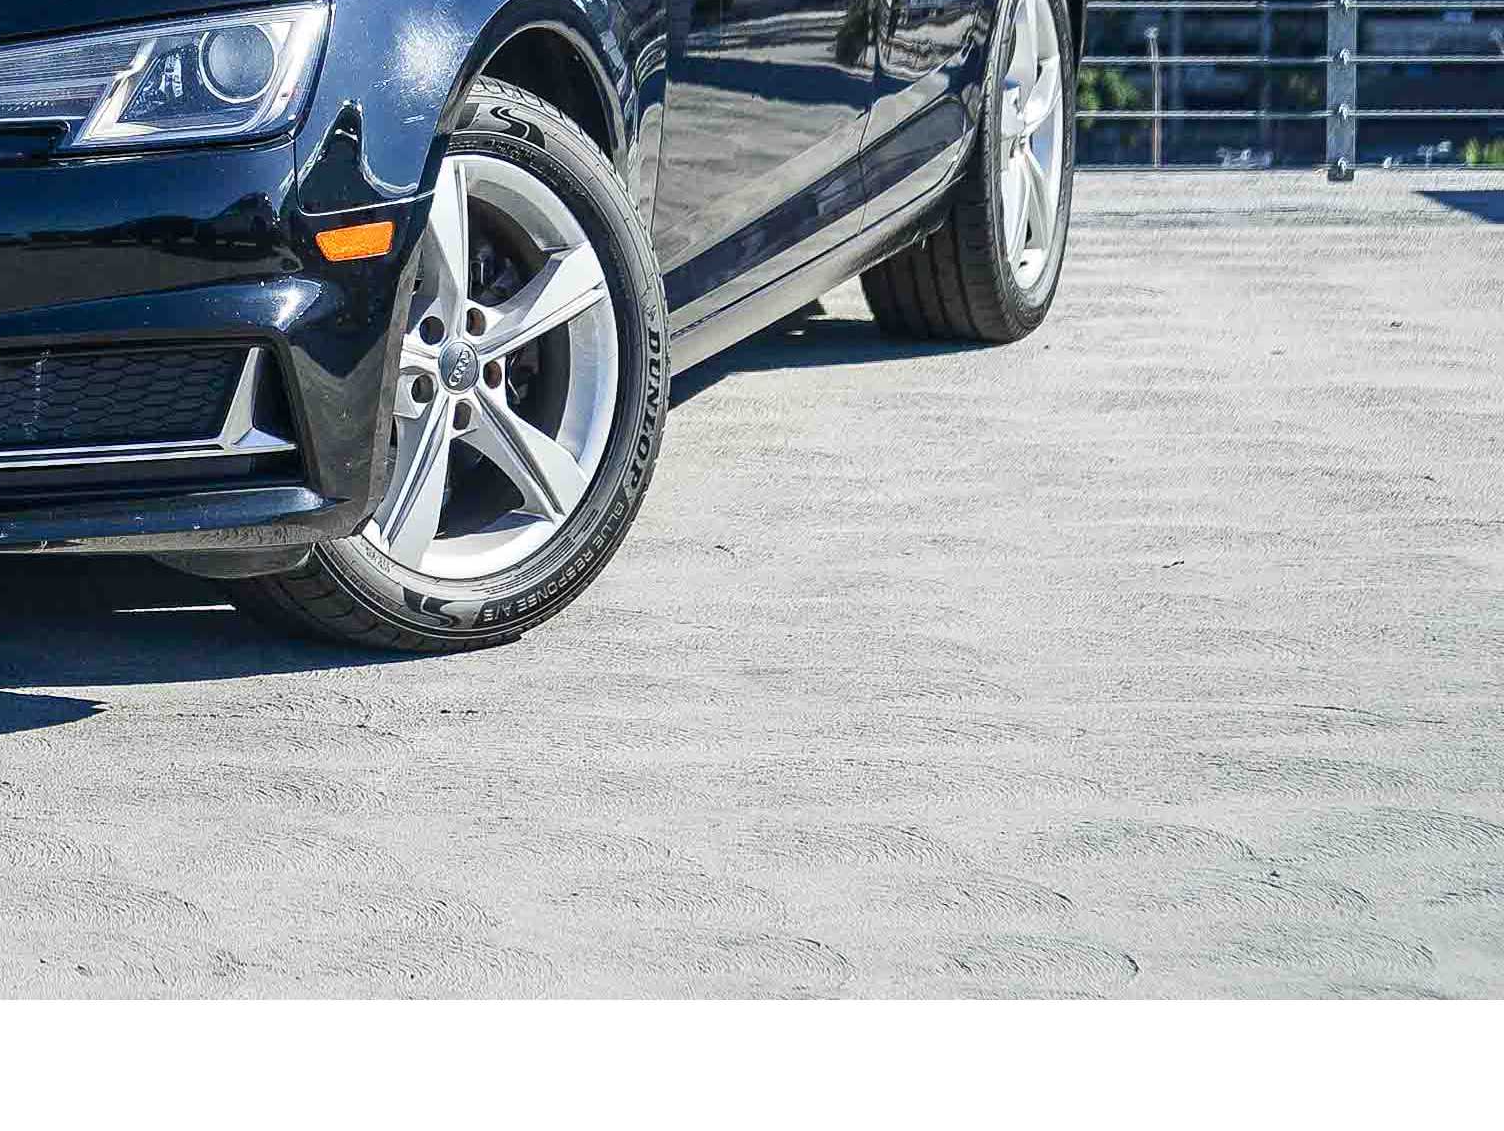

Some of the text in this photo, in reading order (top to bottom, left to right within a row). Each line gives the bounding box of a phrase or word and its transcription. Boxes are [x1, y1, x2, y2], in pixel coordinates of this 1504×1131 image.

[630, 327, 661, 490] DUNLOP
[592, 500, 625, 550] BLUE
[516, 545, 595, 613] RESPONSE
